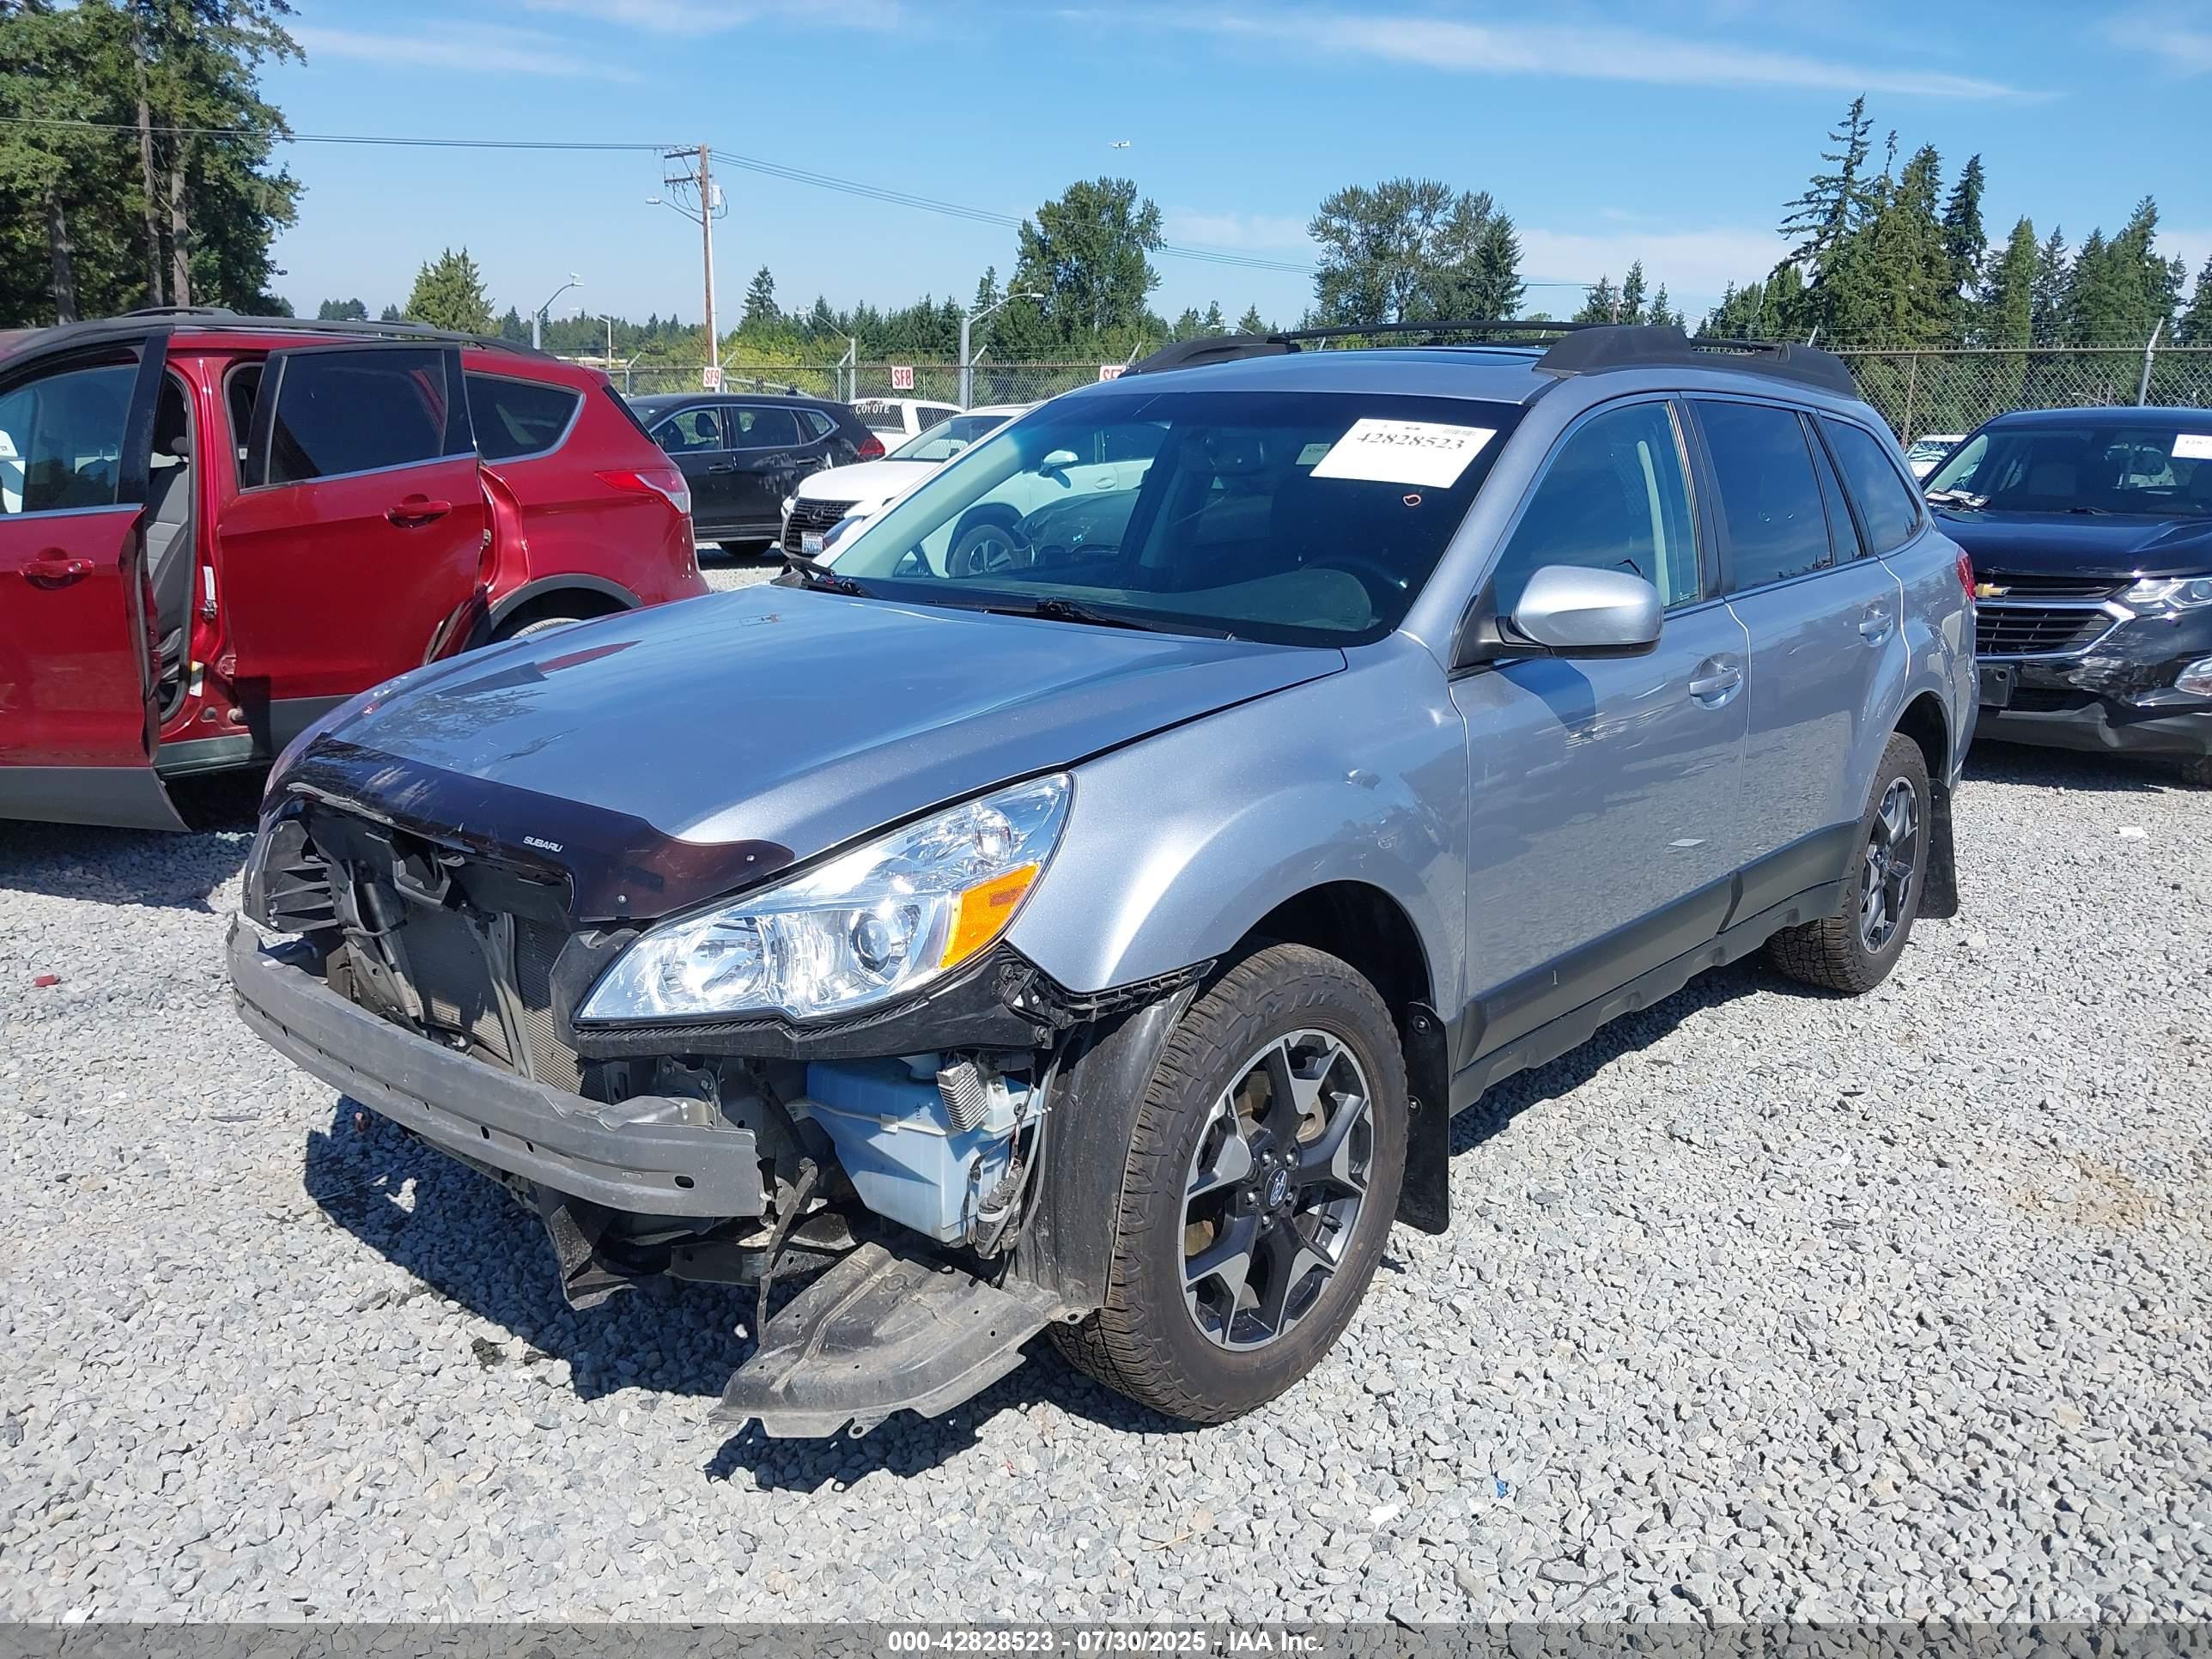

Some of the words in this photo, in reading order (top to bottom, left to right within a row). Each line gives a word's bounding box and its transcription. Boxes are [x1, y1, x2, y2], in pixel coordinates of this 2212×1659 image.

[705, 369, 720, 385] SF9
[894, 369, 912, 386] SF8
[1103, 368, 1121, 379] SF
[855, 404, 890, 414] COYOTE
[1357, 432, 1465, 450] 42828523
[523, 836, 564, 853] SUBARU
